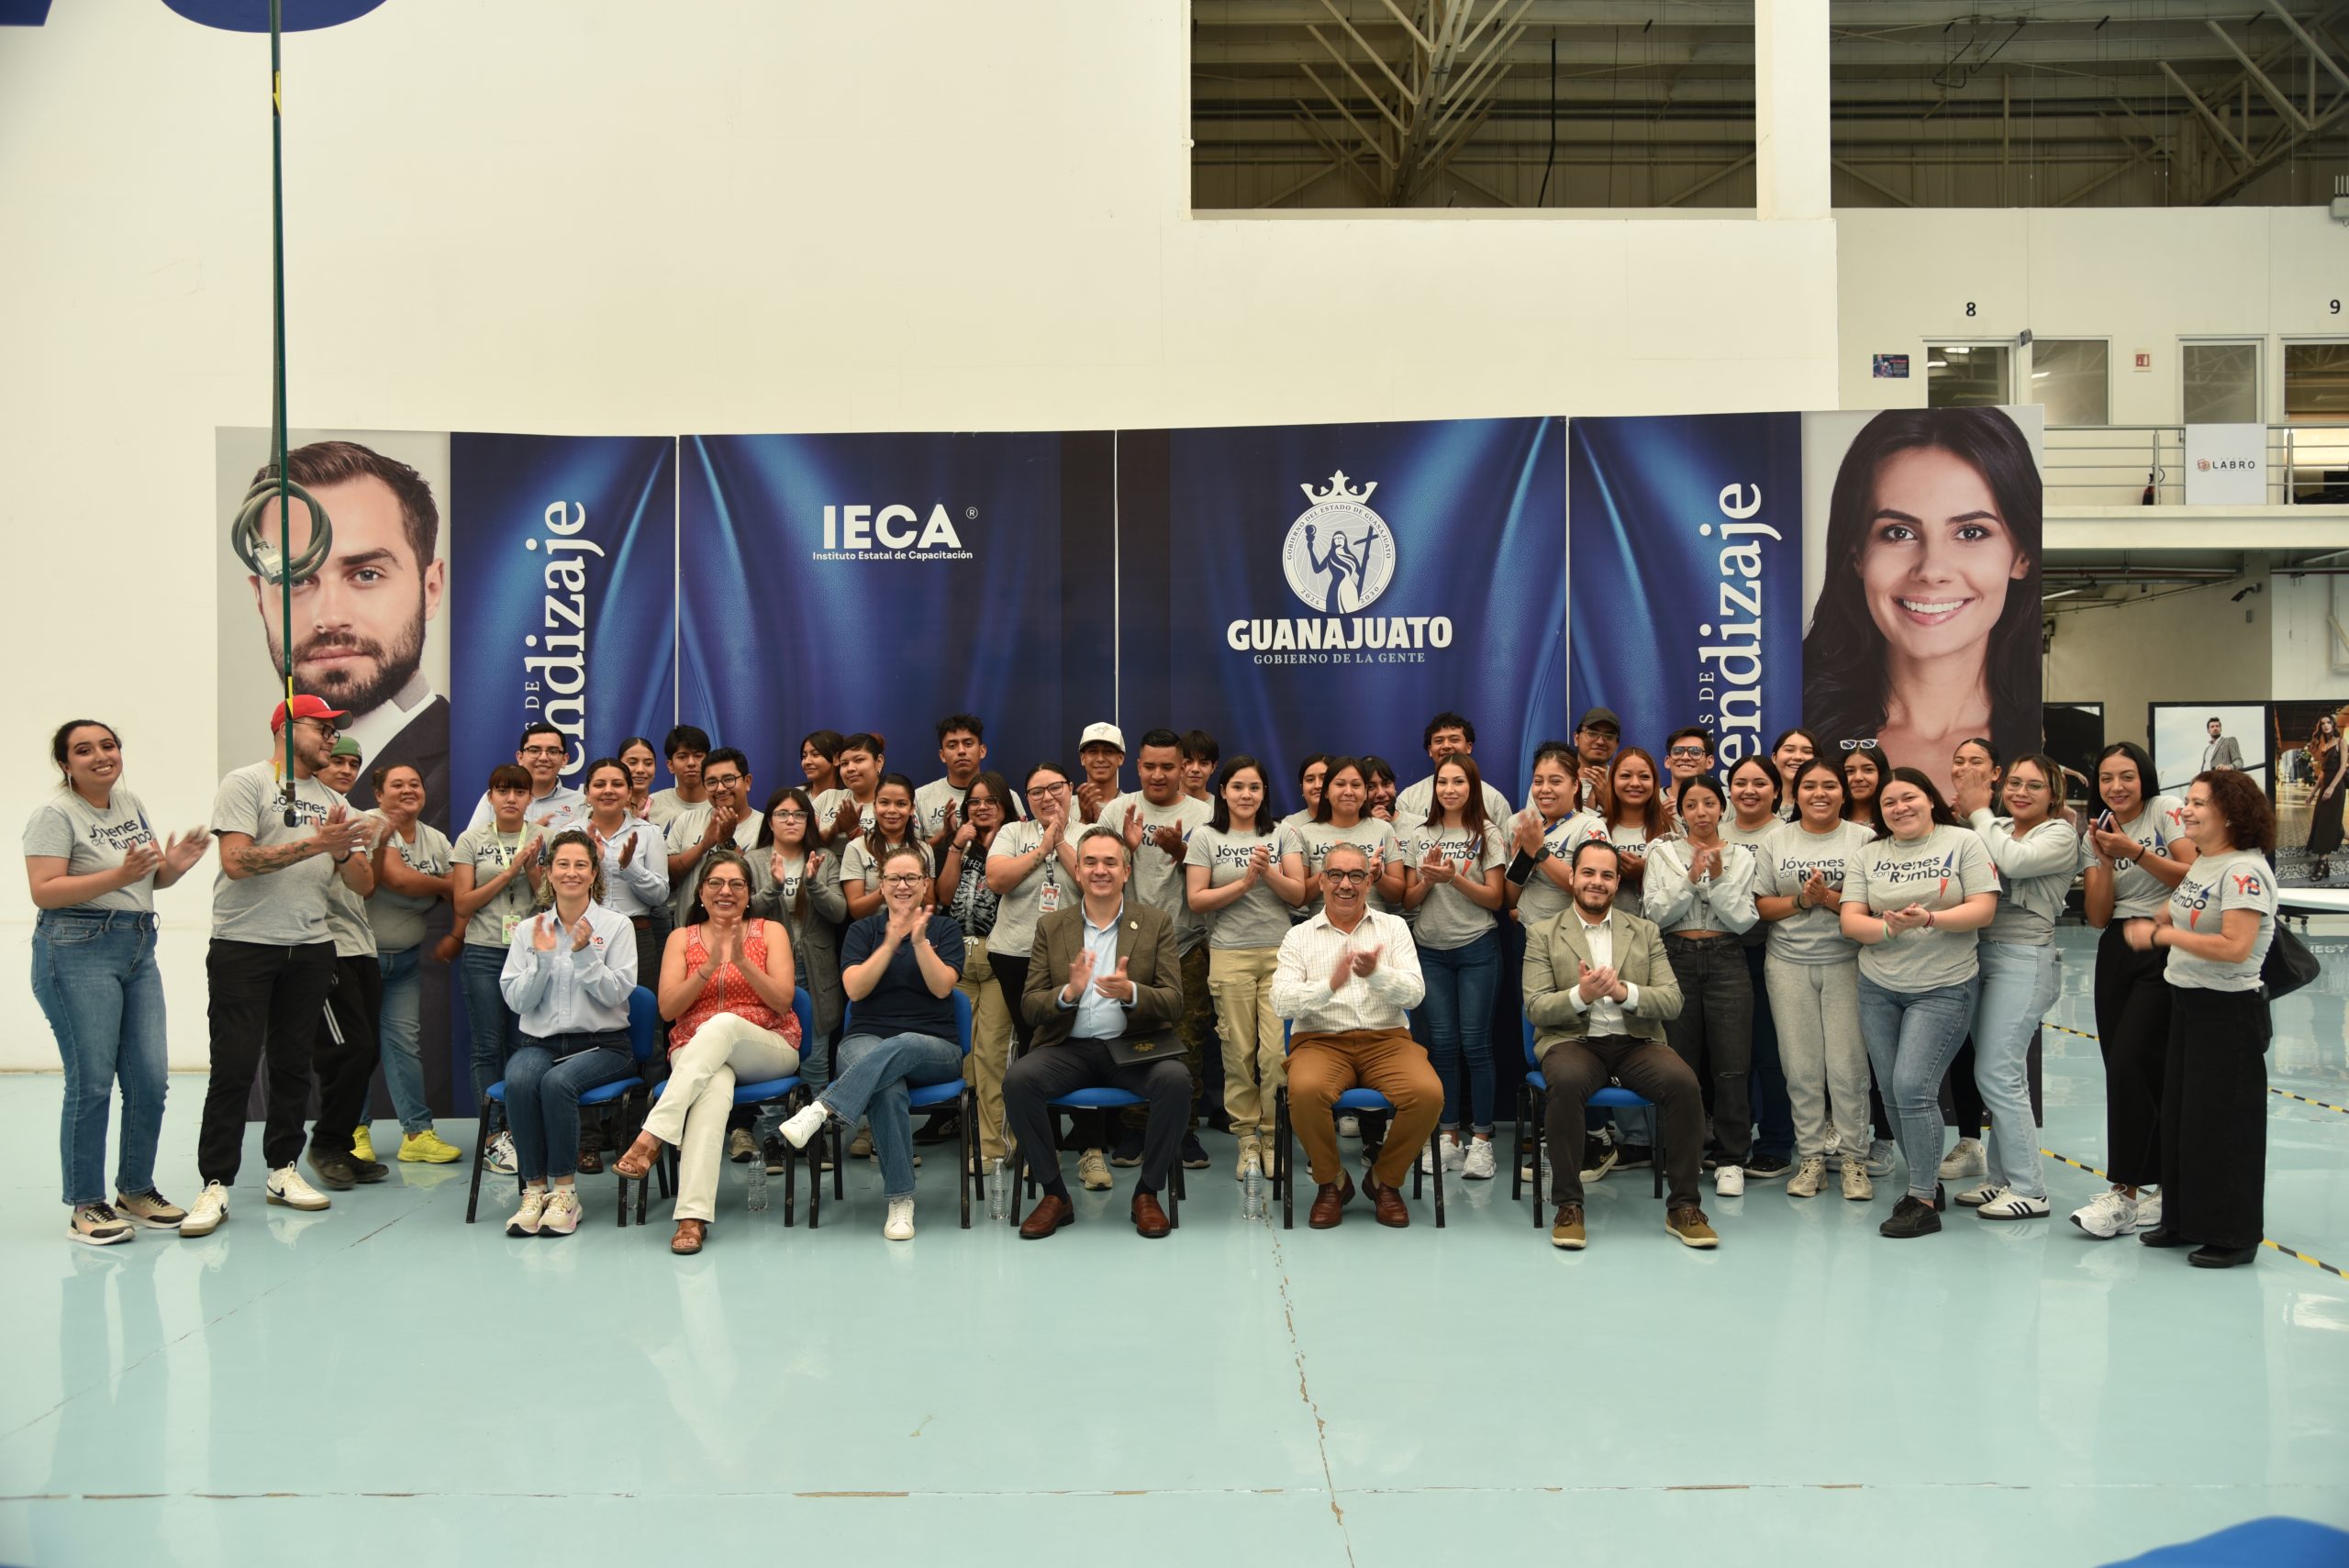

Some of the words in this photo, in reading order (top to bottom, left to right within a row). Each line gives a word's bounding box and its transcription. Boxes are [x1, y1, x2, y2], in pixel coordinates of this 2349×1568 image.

[1965, 301, 1976, 317] 8
[2329, 299, 2341, 315] 9
[2212, 461, 2255, 470] LABRO
[823, 504, 963, 549] IECA
[1286, 521, 1305, 561] GOBIERNO
[1305, 511, 1319, 522] DEL
[1320, 505, 1352, 513] ESTADO
[1353, 506, 1364, 515] DE
[1364, 512, 1392, 559] GUANAJUATO
[813, 551, 856, 561] Instituto
[858, 551, 893, 560] Estatal
[895, 550, 907, 560] de
[908, 550, 973, 562] Capacitación
[1360, 586, 1379, 604] 2030
[1227, 616, 1453, 651] GUANAJUATO
[1253, 653, 1329, 665] GOBIERNO
[1333, 653, 1351, 663] DE
[1355, 652, 1374, 663] LA
[1378, 652, 1426, 663] GENTE
[525, 681, 540, 709] DE
[1698, 672, 1714, 701] DE
[1780, 856, 1845, 872] Jóvenes
[1874, 856, 1941, 873] Jóvenes
[1778, 869, 1798, 879] con
[1870, 870, 1890, 879] con
[1889, 866, 1952, 884] Rumbo
[2232, 874, 2261, 896] YB
